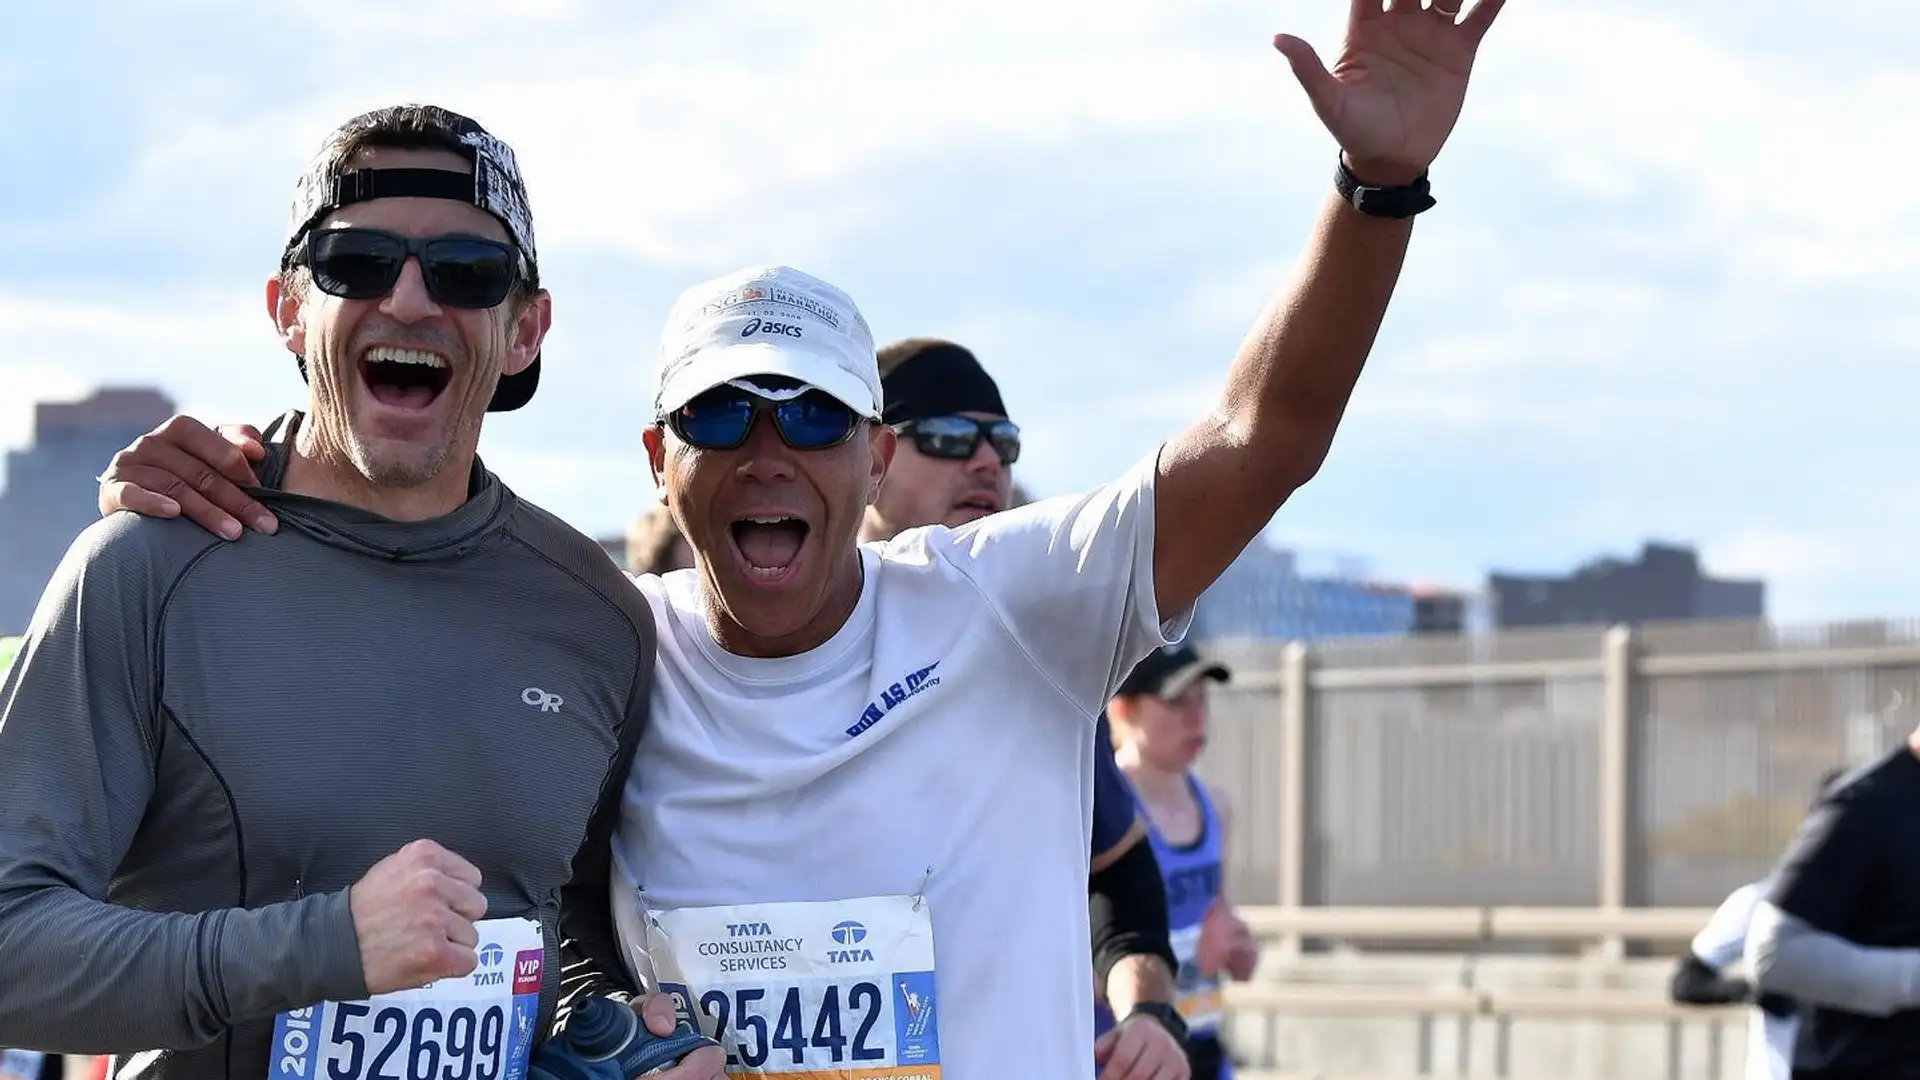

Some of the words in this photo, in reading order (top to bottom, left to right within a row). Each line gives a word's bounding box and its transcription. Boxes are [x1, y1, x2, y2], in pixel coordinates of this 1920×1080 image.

[761, 321, 803, 338] asics
[521, 687, 564, 713] OR
[845, 702, 886, 737] RUN
[880, 682, 907, 711] AS
[727, 923, 772, 937] TATA
[698, 938, 803, 956] CONSULTANCY
[719, 956, 787, 972] SERVICES
[827, 949, 875, 964] TATA
[519, 959, 540, 976] VIP
[473, 971, 504, 986] TATA
[700, 981, 885, 1067] 25442
[327, 1002, 504, 1080] 52699
